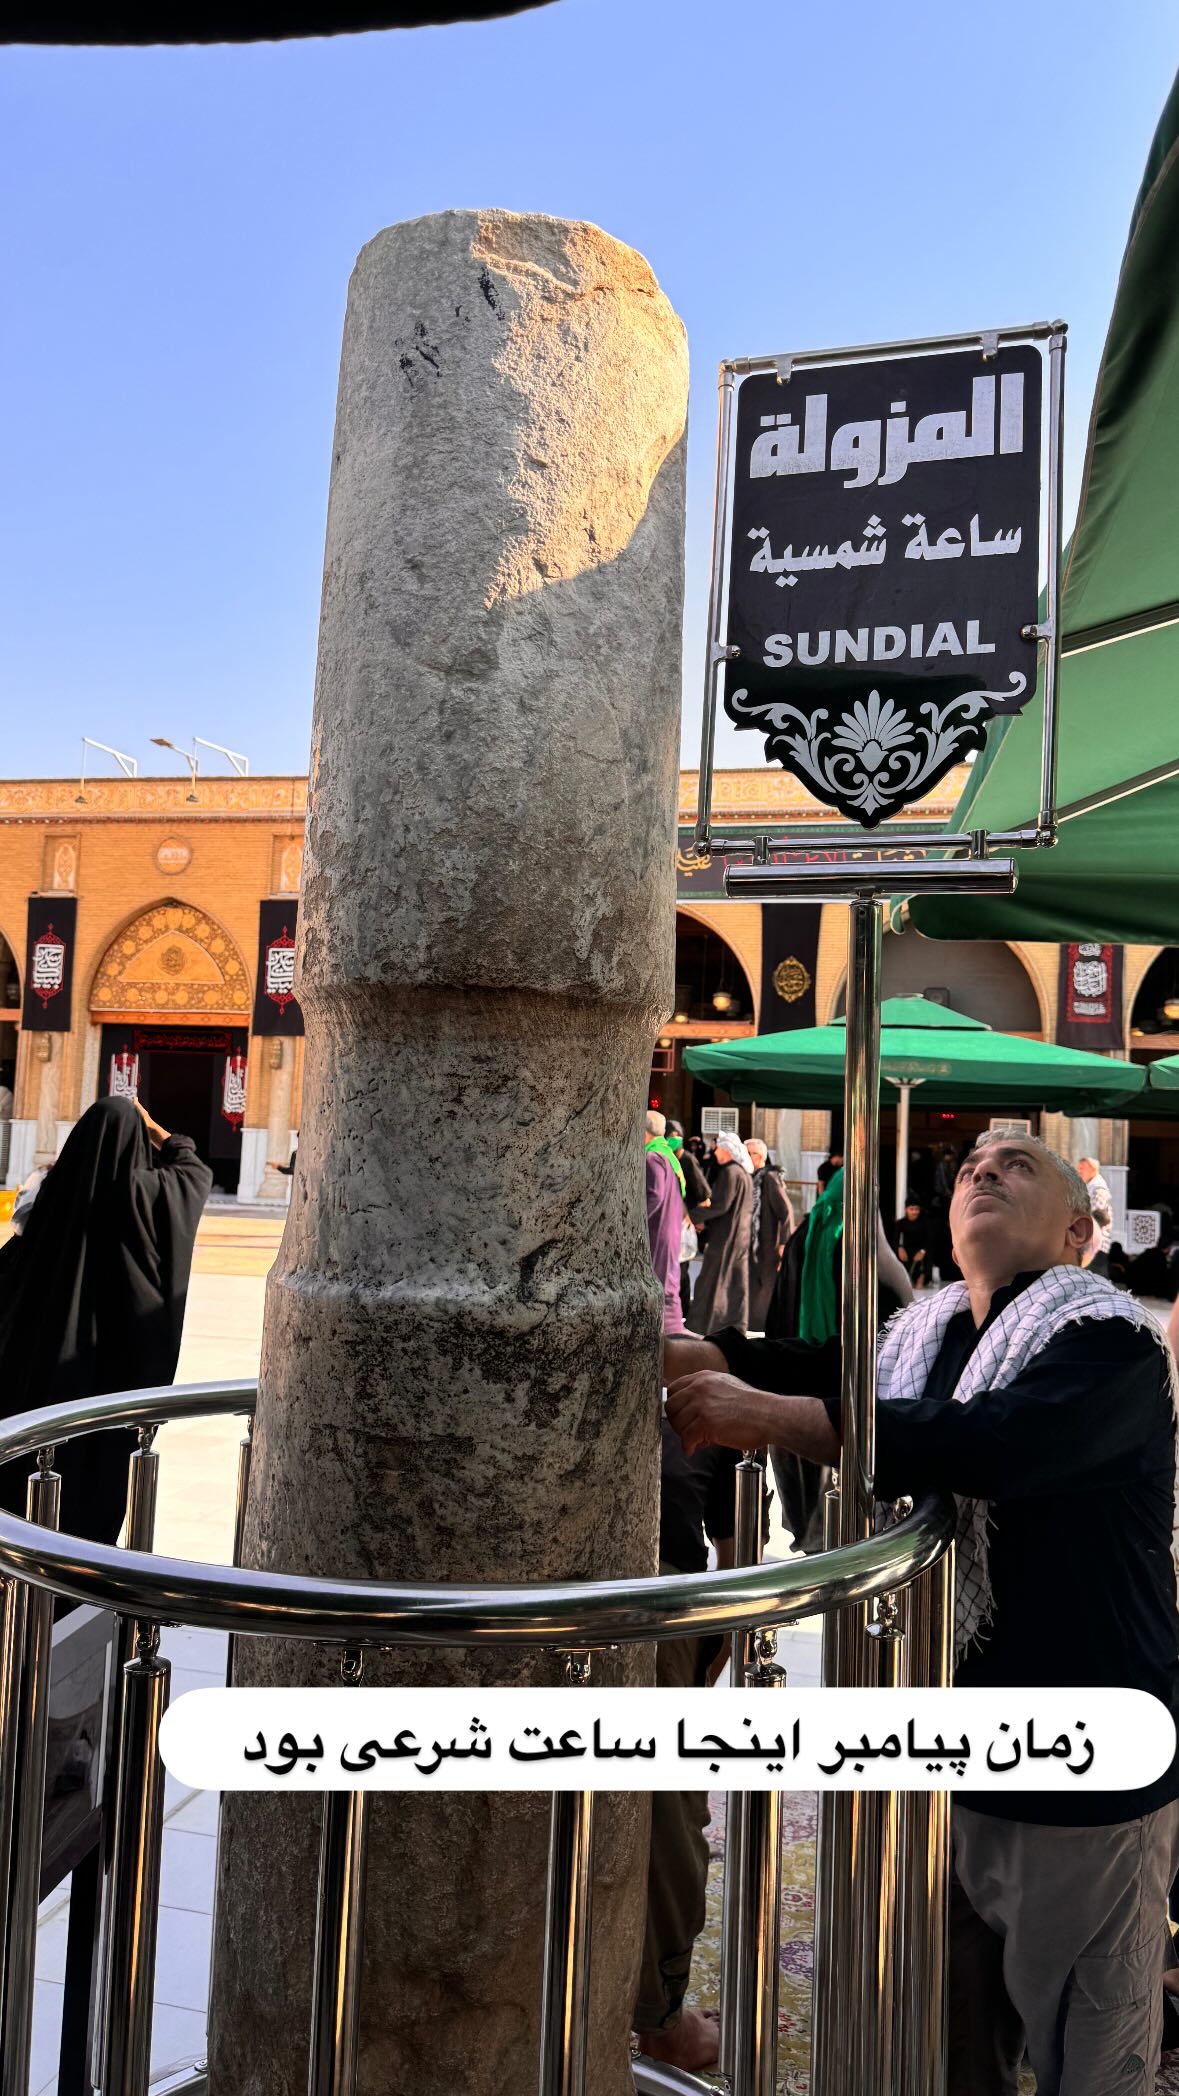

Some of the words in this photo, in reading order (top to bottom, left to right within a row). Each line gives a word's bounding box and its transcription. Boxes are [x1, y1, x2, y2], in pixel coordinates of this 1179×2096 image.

[748, 372, 1025, 489] المزولة
[747, 514, 888, 588] شمسية
[901, 512, 1022, 561] ساعة
[762, 619, 996, 668] SUNDIAL
